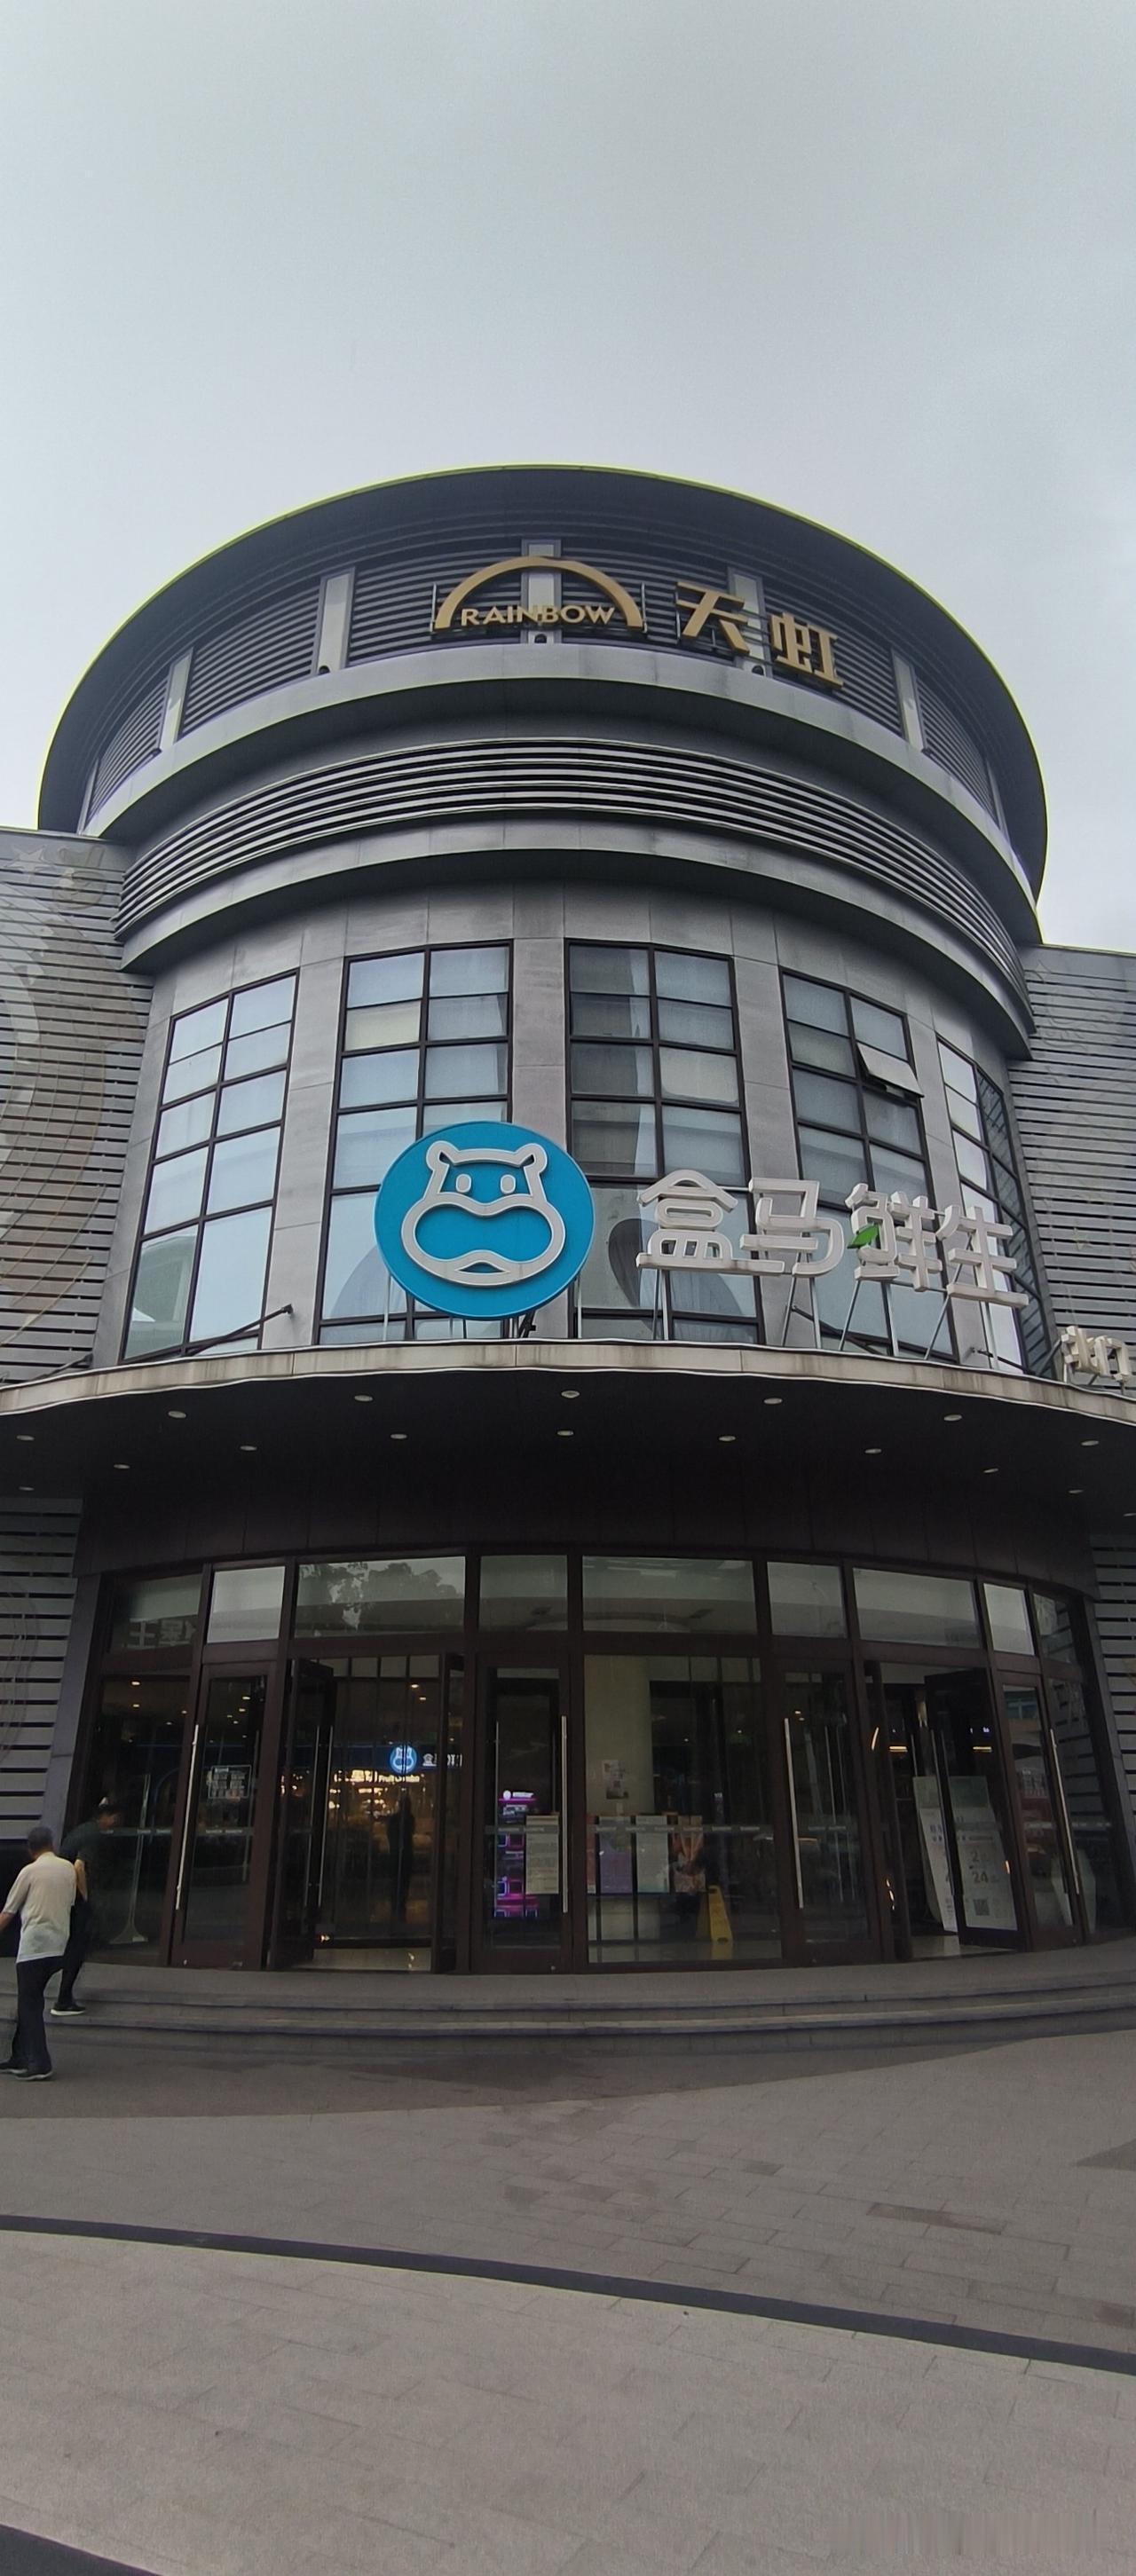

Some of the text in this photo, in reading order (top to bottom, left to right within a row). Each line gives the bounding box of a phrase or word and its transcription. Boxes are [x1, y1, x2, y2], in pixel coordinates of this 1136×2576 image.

[461, 605, 615, 627] RAINBOW
[676, 581, 844, 689] 天虹
[636, 1170, 1029, 1309] 盒马鲜生
